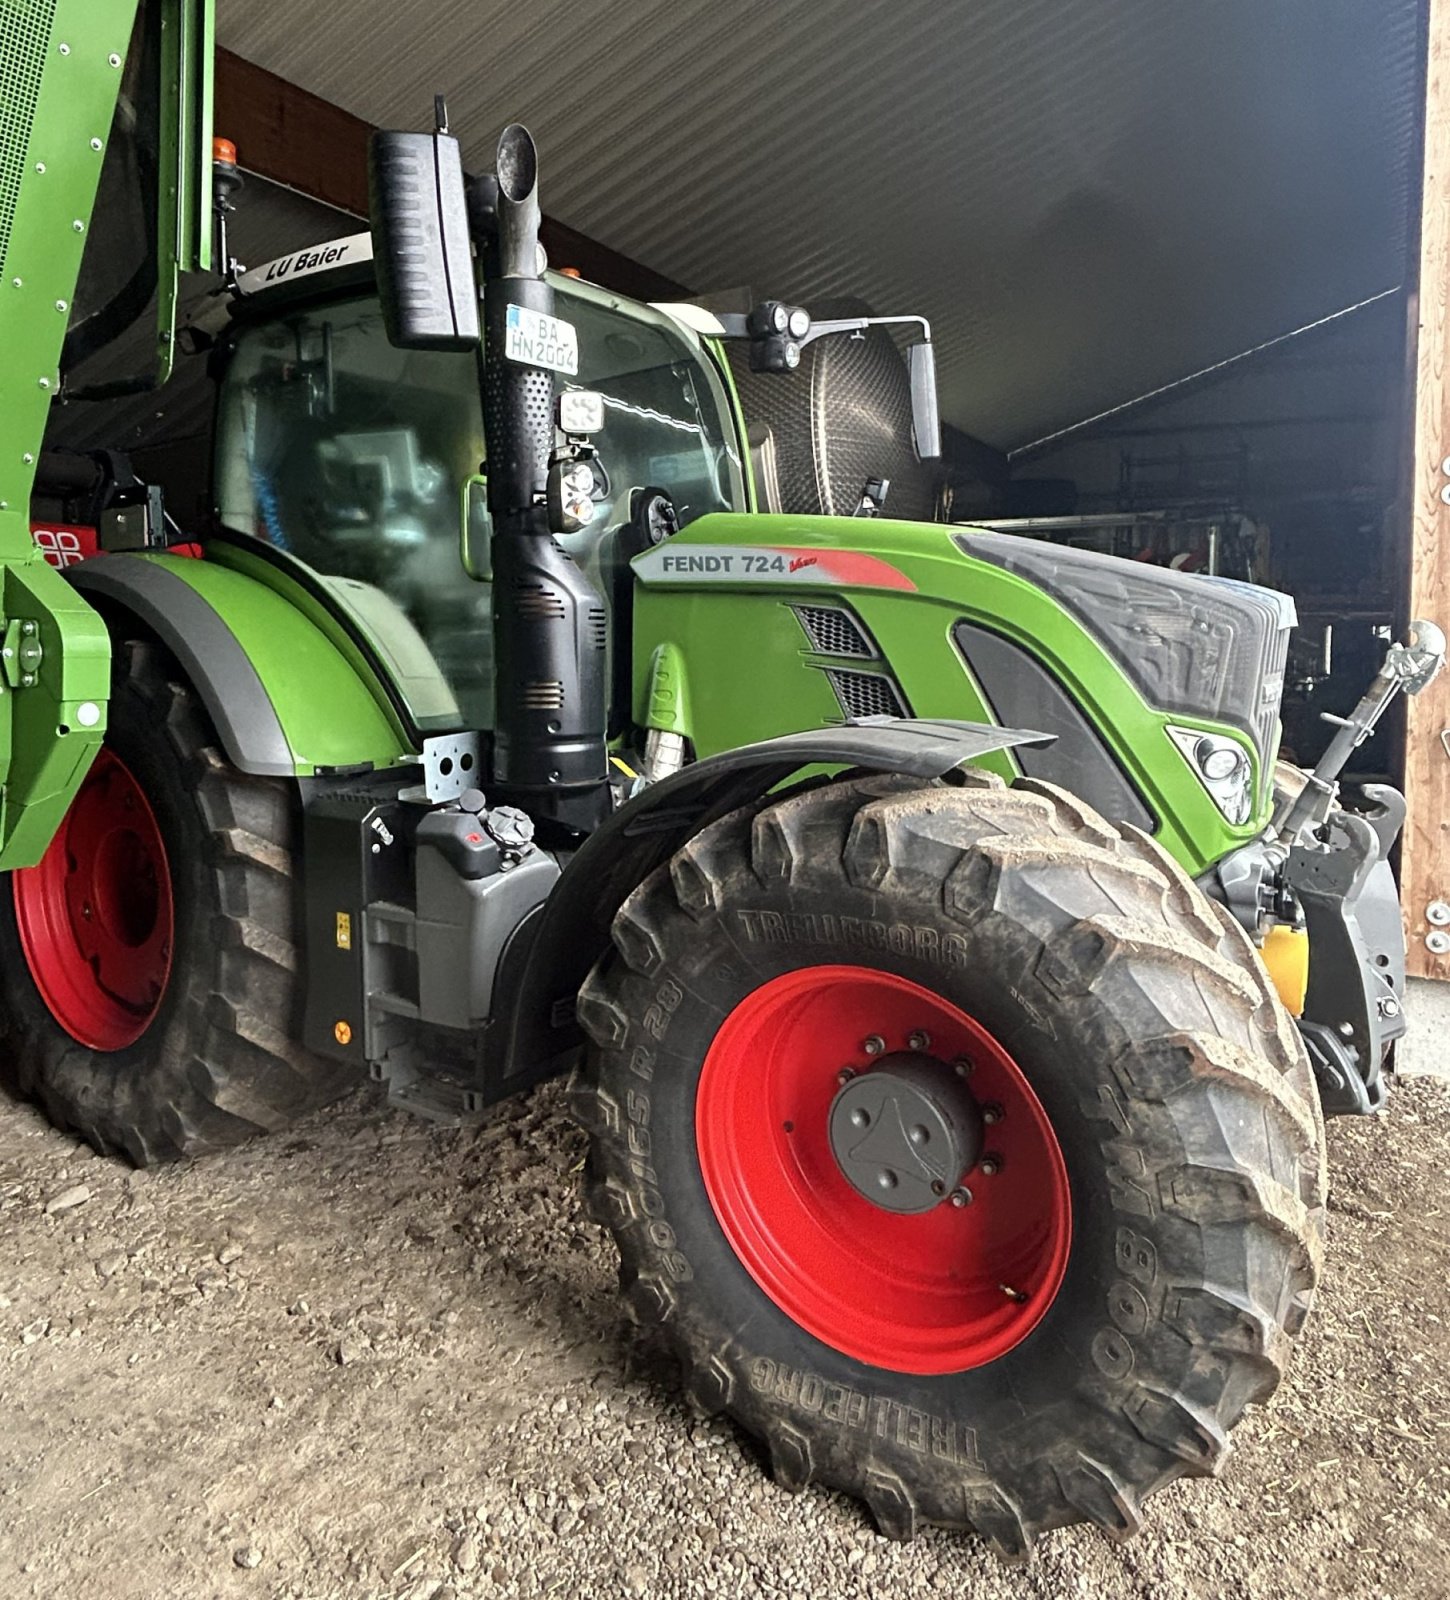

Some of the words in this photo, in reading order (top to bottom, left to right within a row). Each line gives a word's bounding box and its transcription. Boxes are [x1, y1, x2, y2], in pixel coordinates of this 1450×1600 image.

[265, 258, 293, 281] LU
[293, 245, 349, 273] Baier
[539, 319, 558, 343] BA
[662, 555, 733, 573] FENDT
[741, 556, 784, 573] 724
[737, 909, 967, 967] TRELLEBORG
[629, 1045, 657, 1081] R
[643, 979, 683, 1041] 28
[750, 1356, 987, 1472] TRELLEBORG
